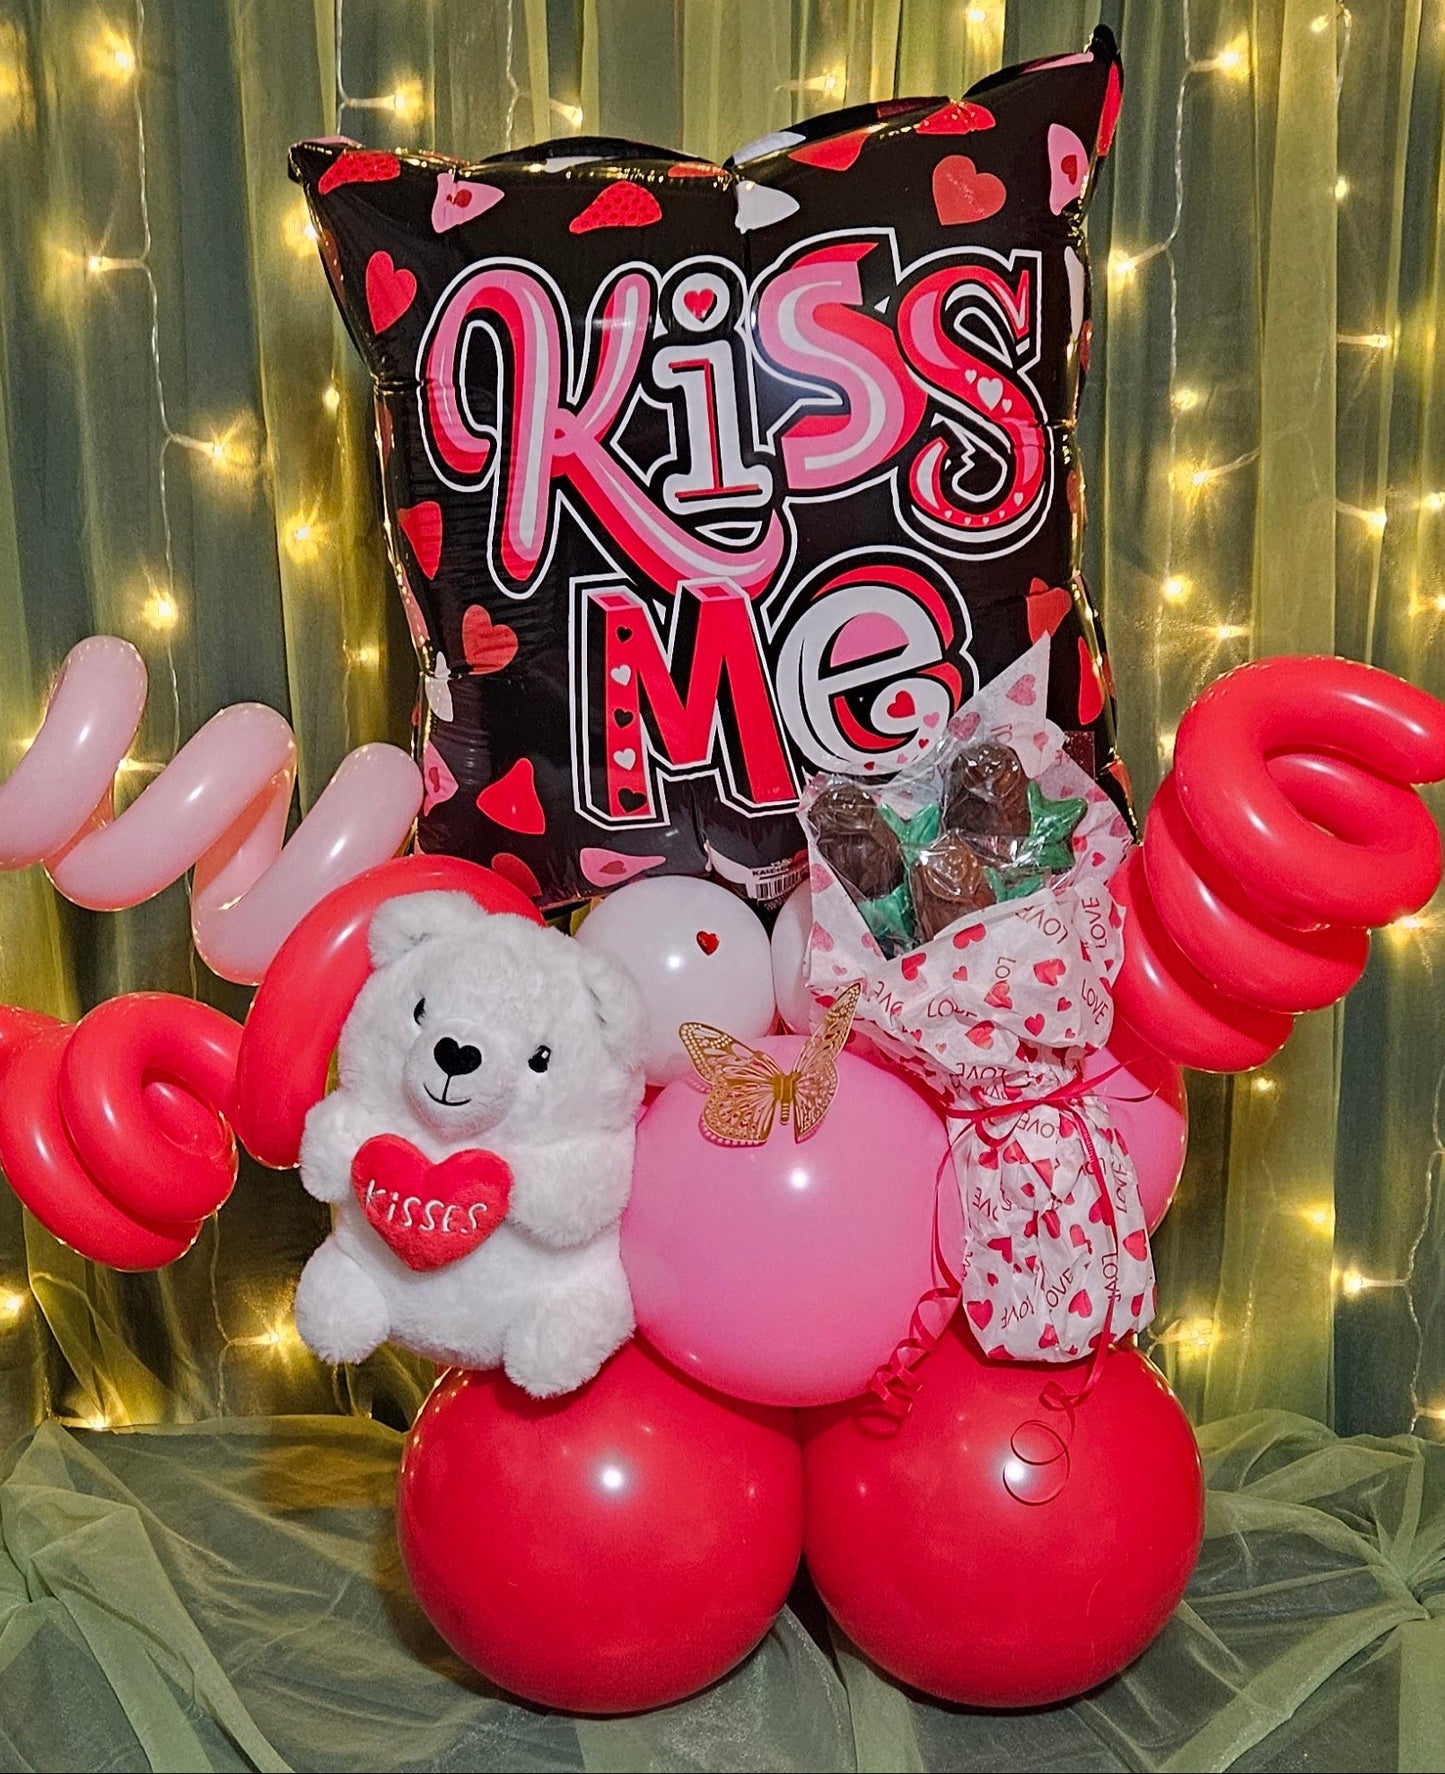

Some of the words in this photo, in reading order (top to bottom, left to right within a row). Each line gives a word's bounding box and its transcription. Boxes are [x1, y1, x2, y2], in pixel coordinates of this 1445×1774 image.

[1081, 897, 1108, 949] LOVE
[1081, 978, 1109, 1025] LOVE
[1016, 1111, 1056, 1139] OVE
[1045, 1267, 1075, 1308] OVE
